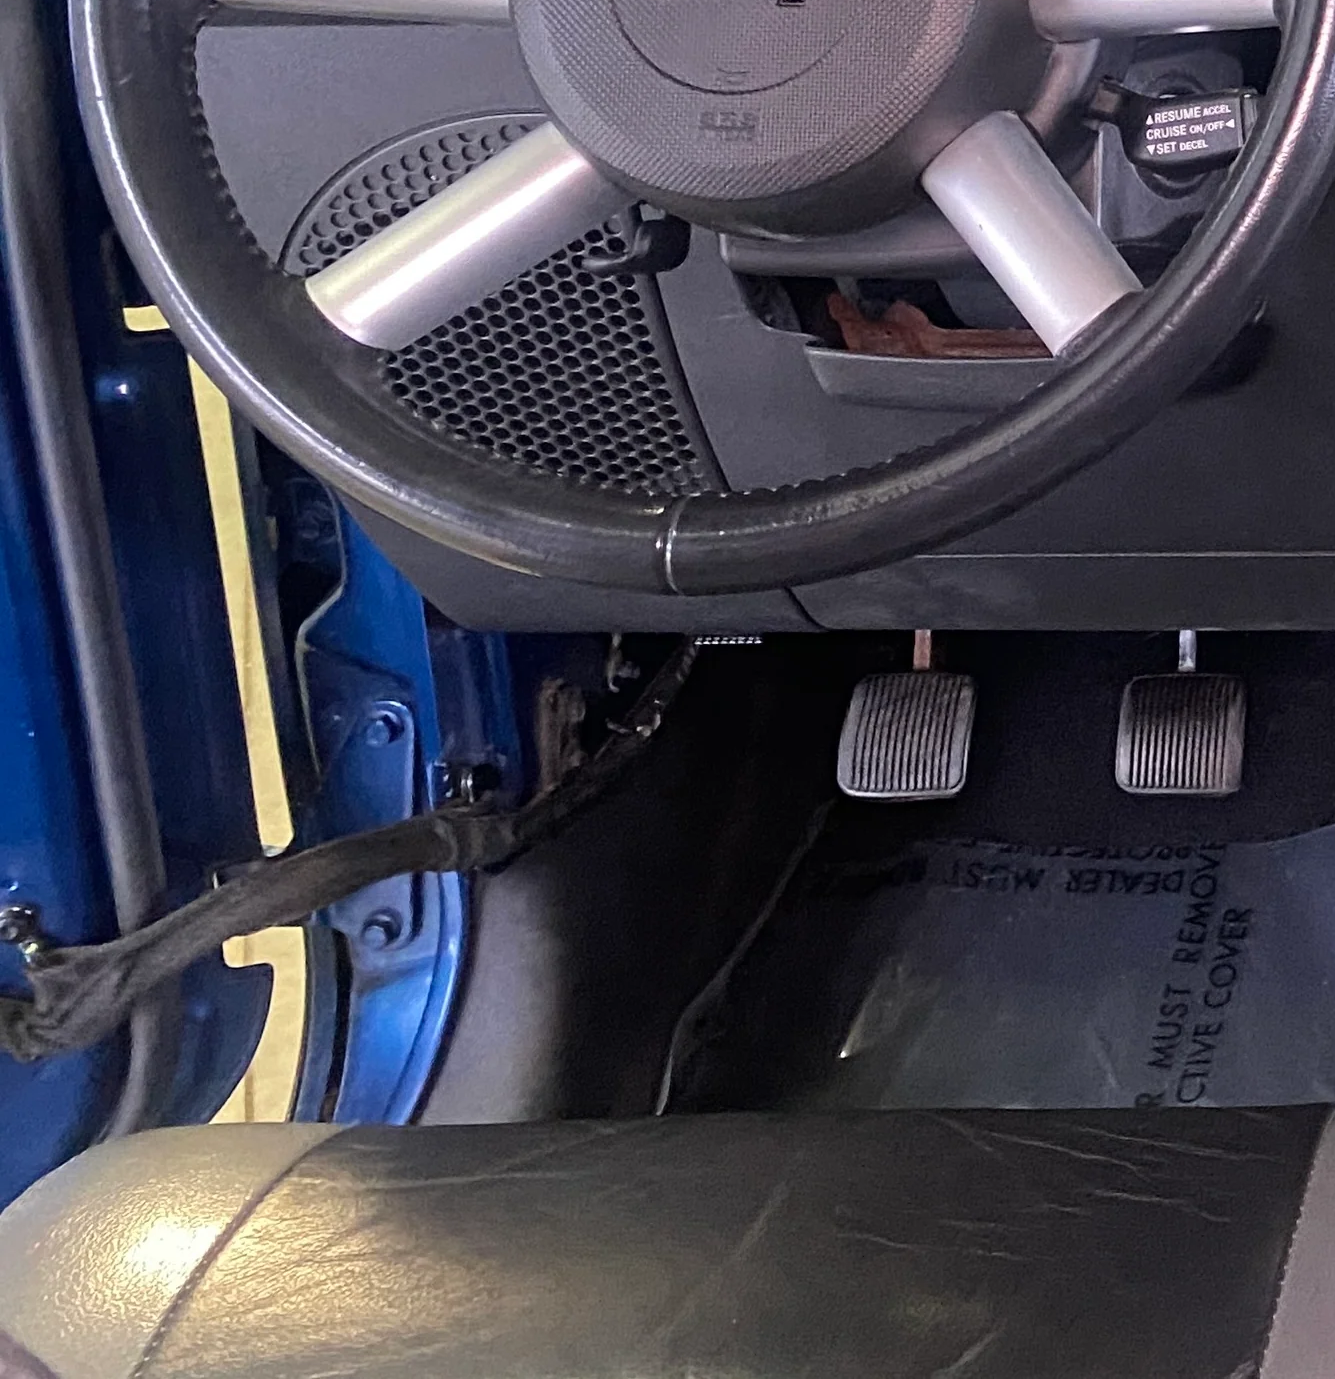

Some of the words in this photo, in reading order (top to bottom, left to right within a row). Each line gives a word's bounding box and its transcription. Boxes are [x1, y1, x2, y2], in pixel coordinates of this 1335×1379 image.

[1154, 106, 1201, 124] RESUME
[1202, 104, 1232, 118] ACCEL
[1145, 124, 1187, 141] CRUISE
[1189, 120, 1225, 136] ON/OFF
[1155, 141, 1177, 156] SET
[1179, 139, 1209, 153] DECEL
[1176, 1021, 1223, 1104] CTIVE
[1203, 907, 1253, 1010] COVER
[1148, 983, 1191, 1069] MUST
